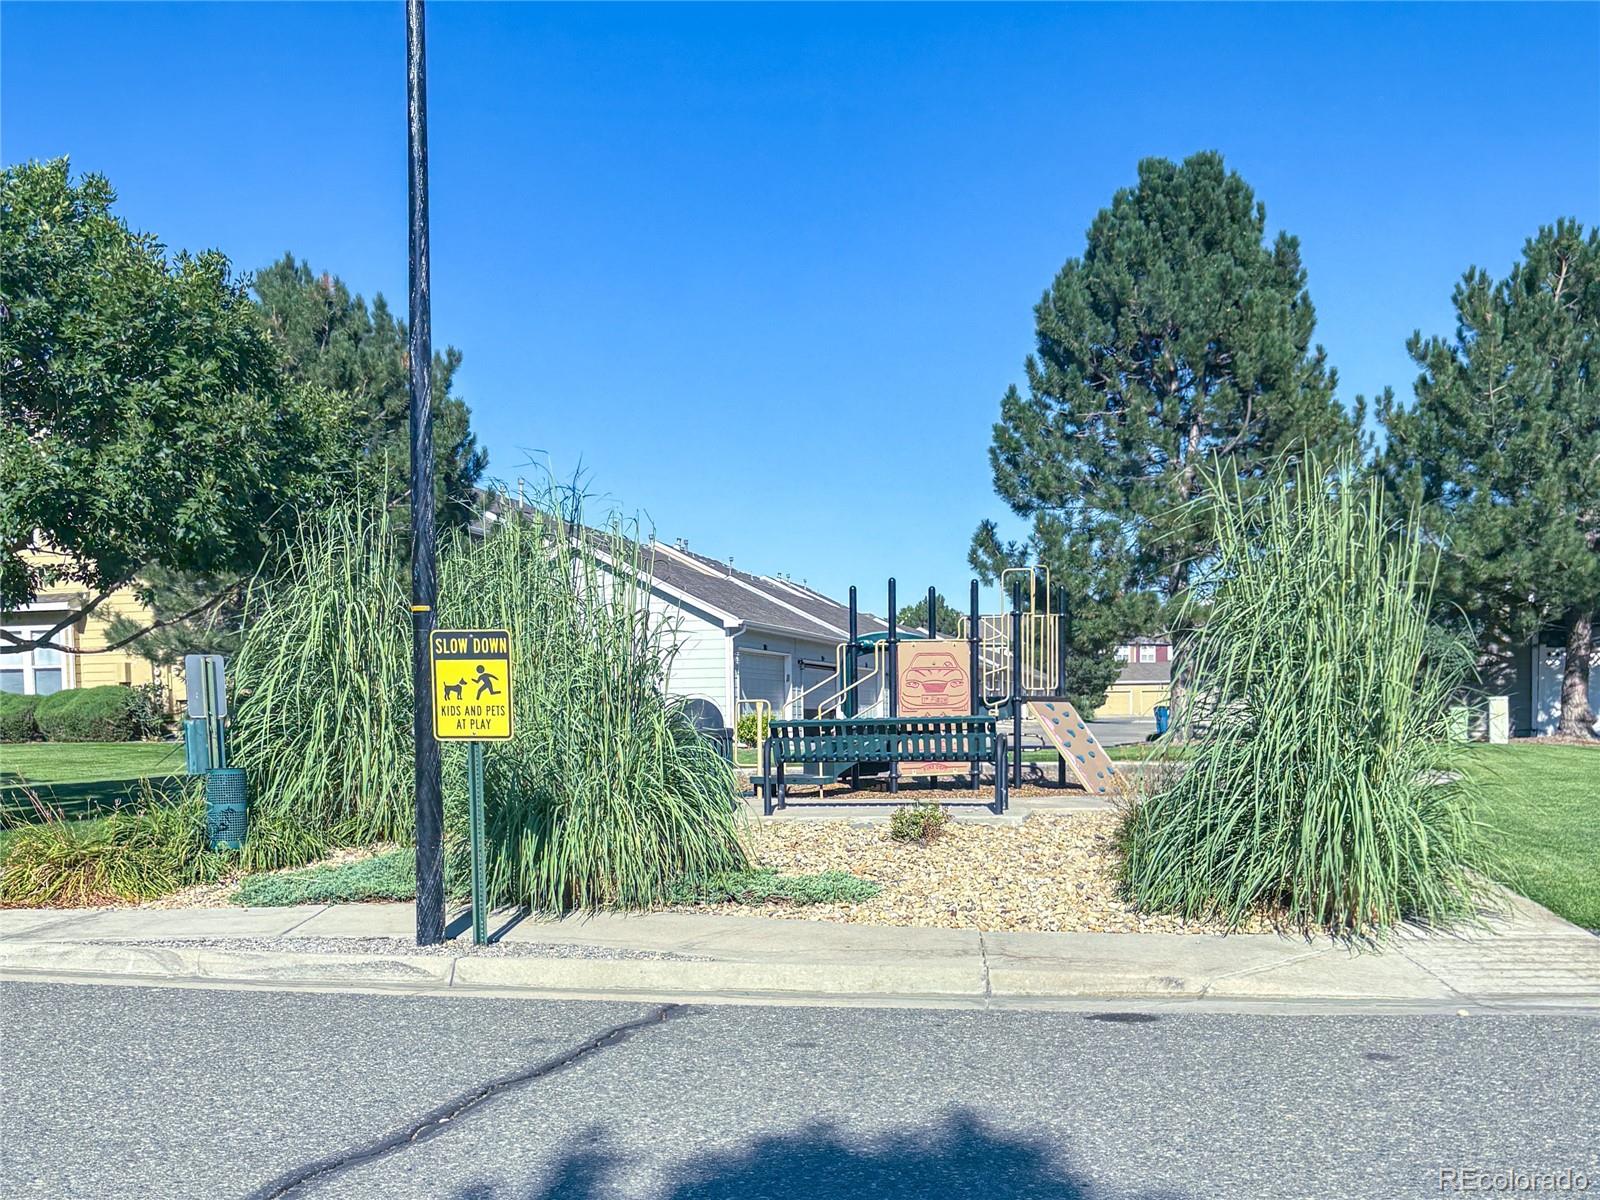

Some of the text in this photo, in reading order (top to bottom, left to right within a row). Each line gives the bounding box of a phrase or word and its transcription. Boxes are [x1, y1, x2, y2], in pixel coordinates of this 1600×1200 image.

[435, 637, 507, 654] SLOW DOWN
[441, 705, 505, 716] KIDS AND PETS
[456, 719, 491, 730] AT PLAY
